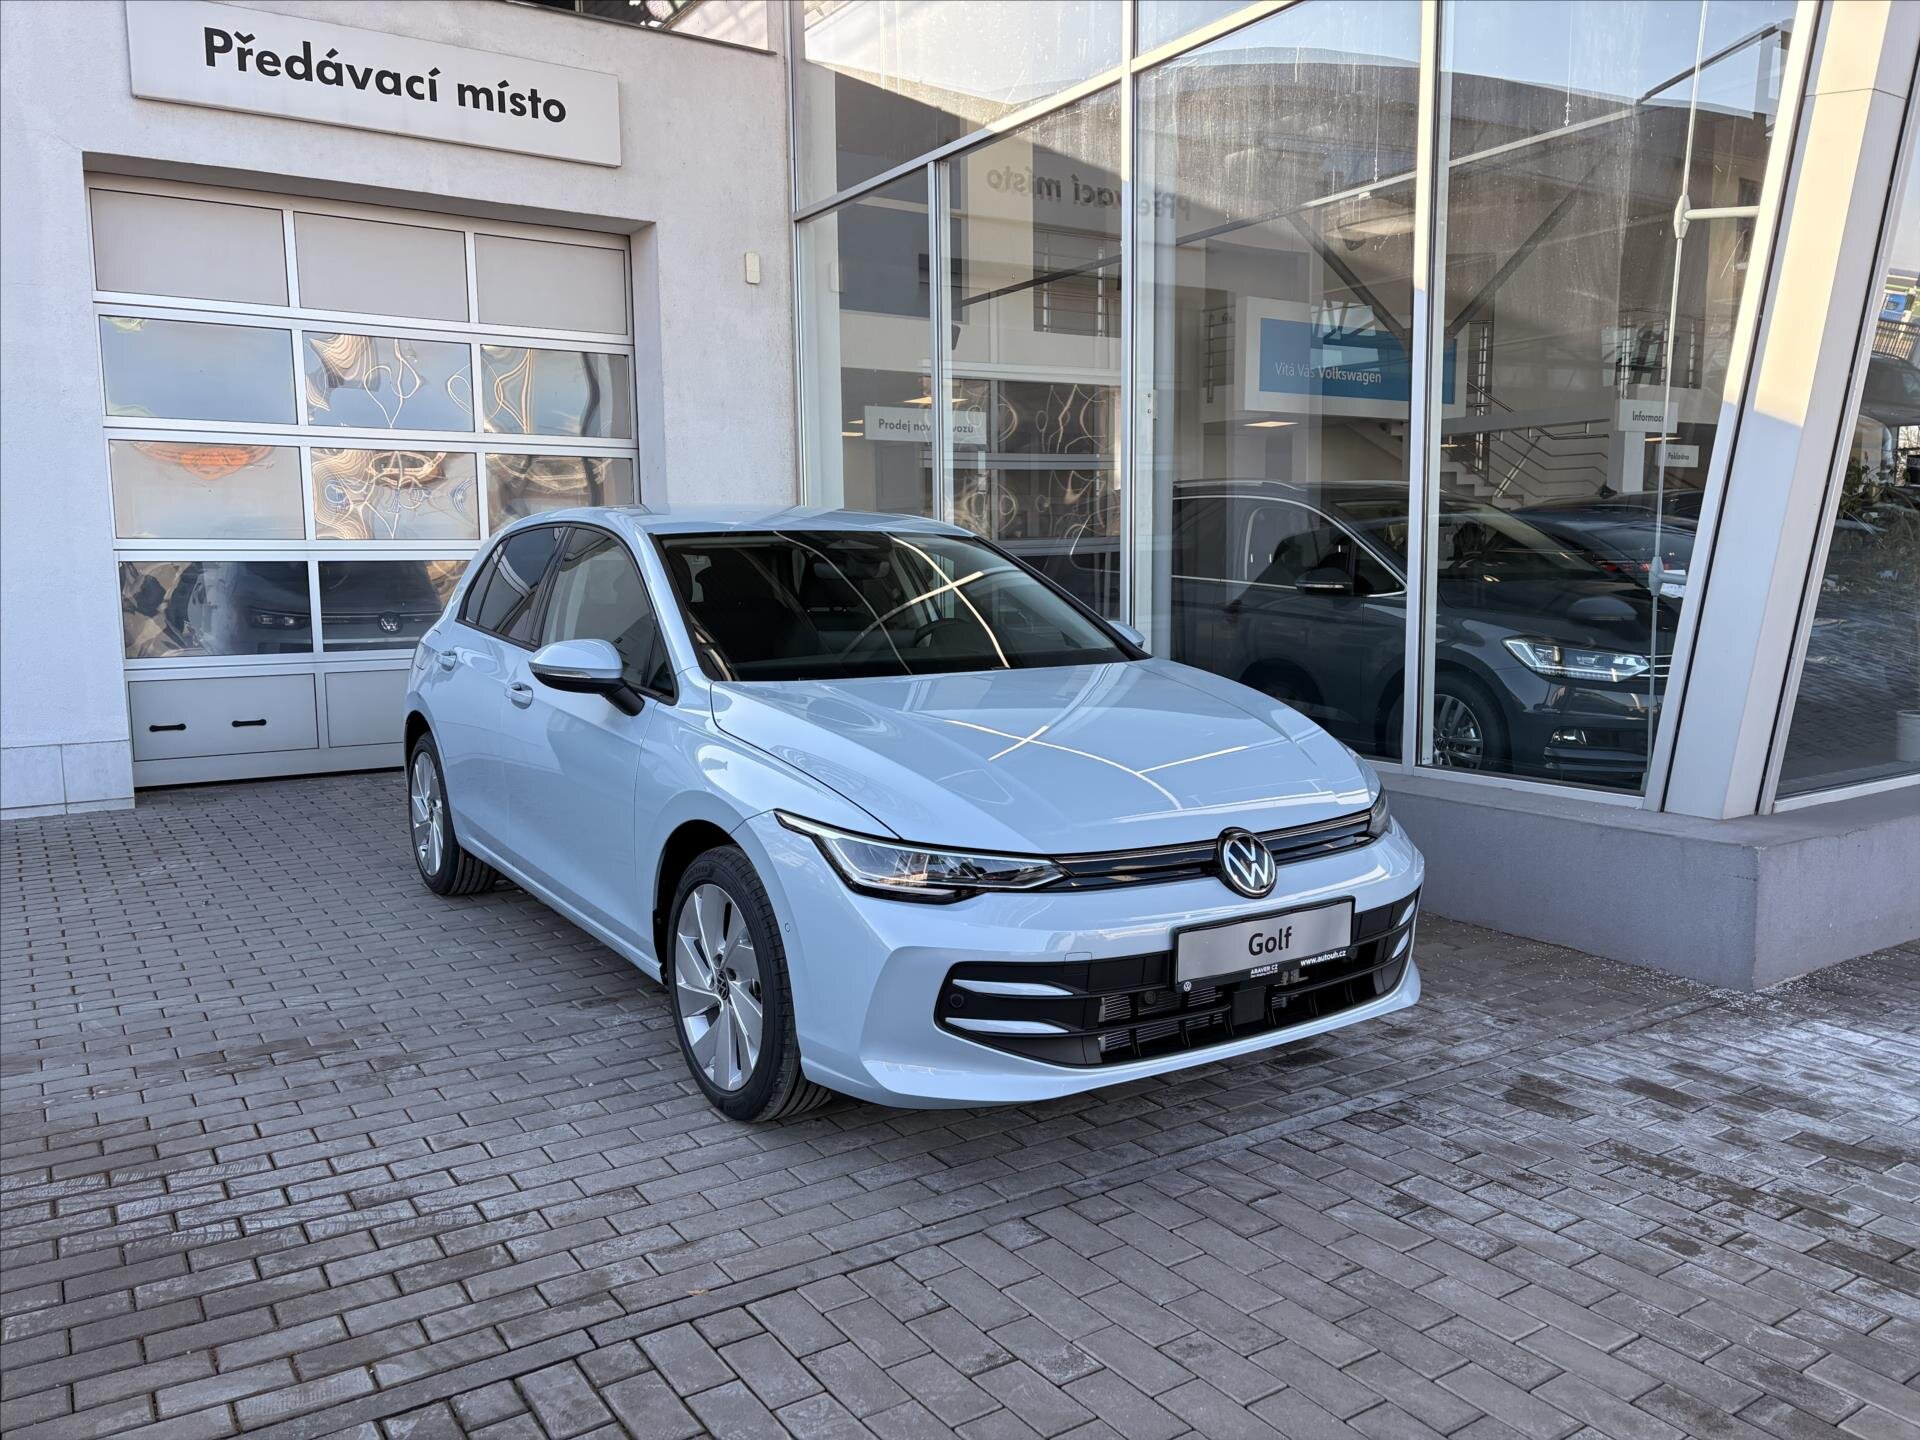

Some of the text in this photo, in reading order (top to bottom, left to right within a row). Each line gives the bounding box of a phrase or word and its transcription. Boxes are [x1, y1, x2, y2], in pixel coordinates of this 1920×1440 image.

[203, 26, 567, 124] Předávací místo
[1318, 366, 1382, 385] Volkswagen
[878, 418, 911, 433] Prodej
[1248, 926, 1293, 956] Golf
[1300, 950, 1346, 967] www.autouh.cz
